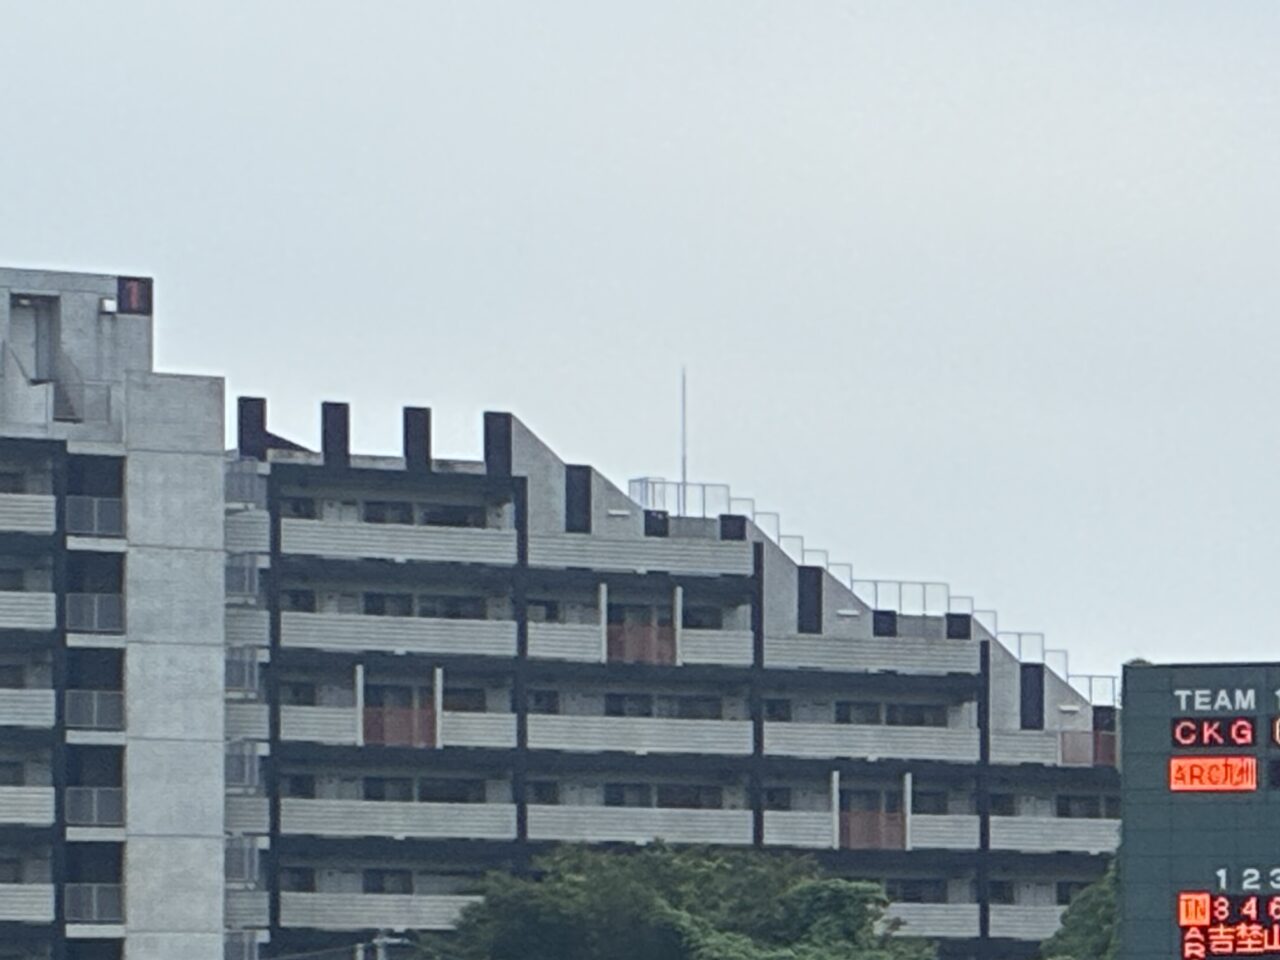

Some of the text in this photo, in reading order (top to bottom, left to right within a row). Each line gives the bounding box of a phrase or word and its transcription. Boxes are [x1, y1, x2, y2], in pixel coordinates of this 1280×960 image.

[1174, 689, 1256, 710] TEAM
[1175, 715, 1253, 745] CKG
[1215, 868, 1227, 890] 1
[1242, 868, 1261, 890] 2
[1241, 896, 1258, 920] 4
